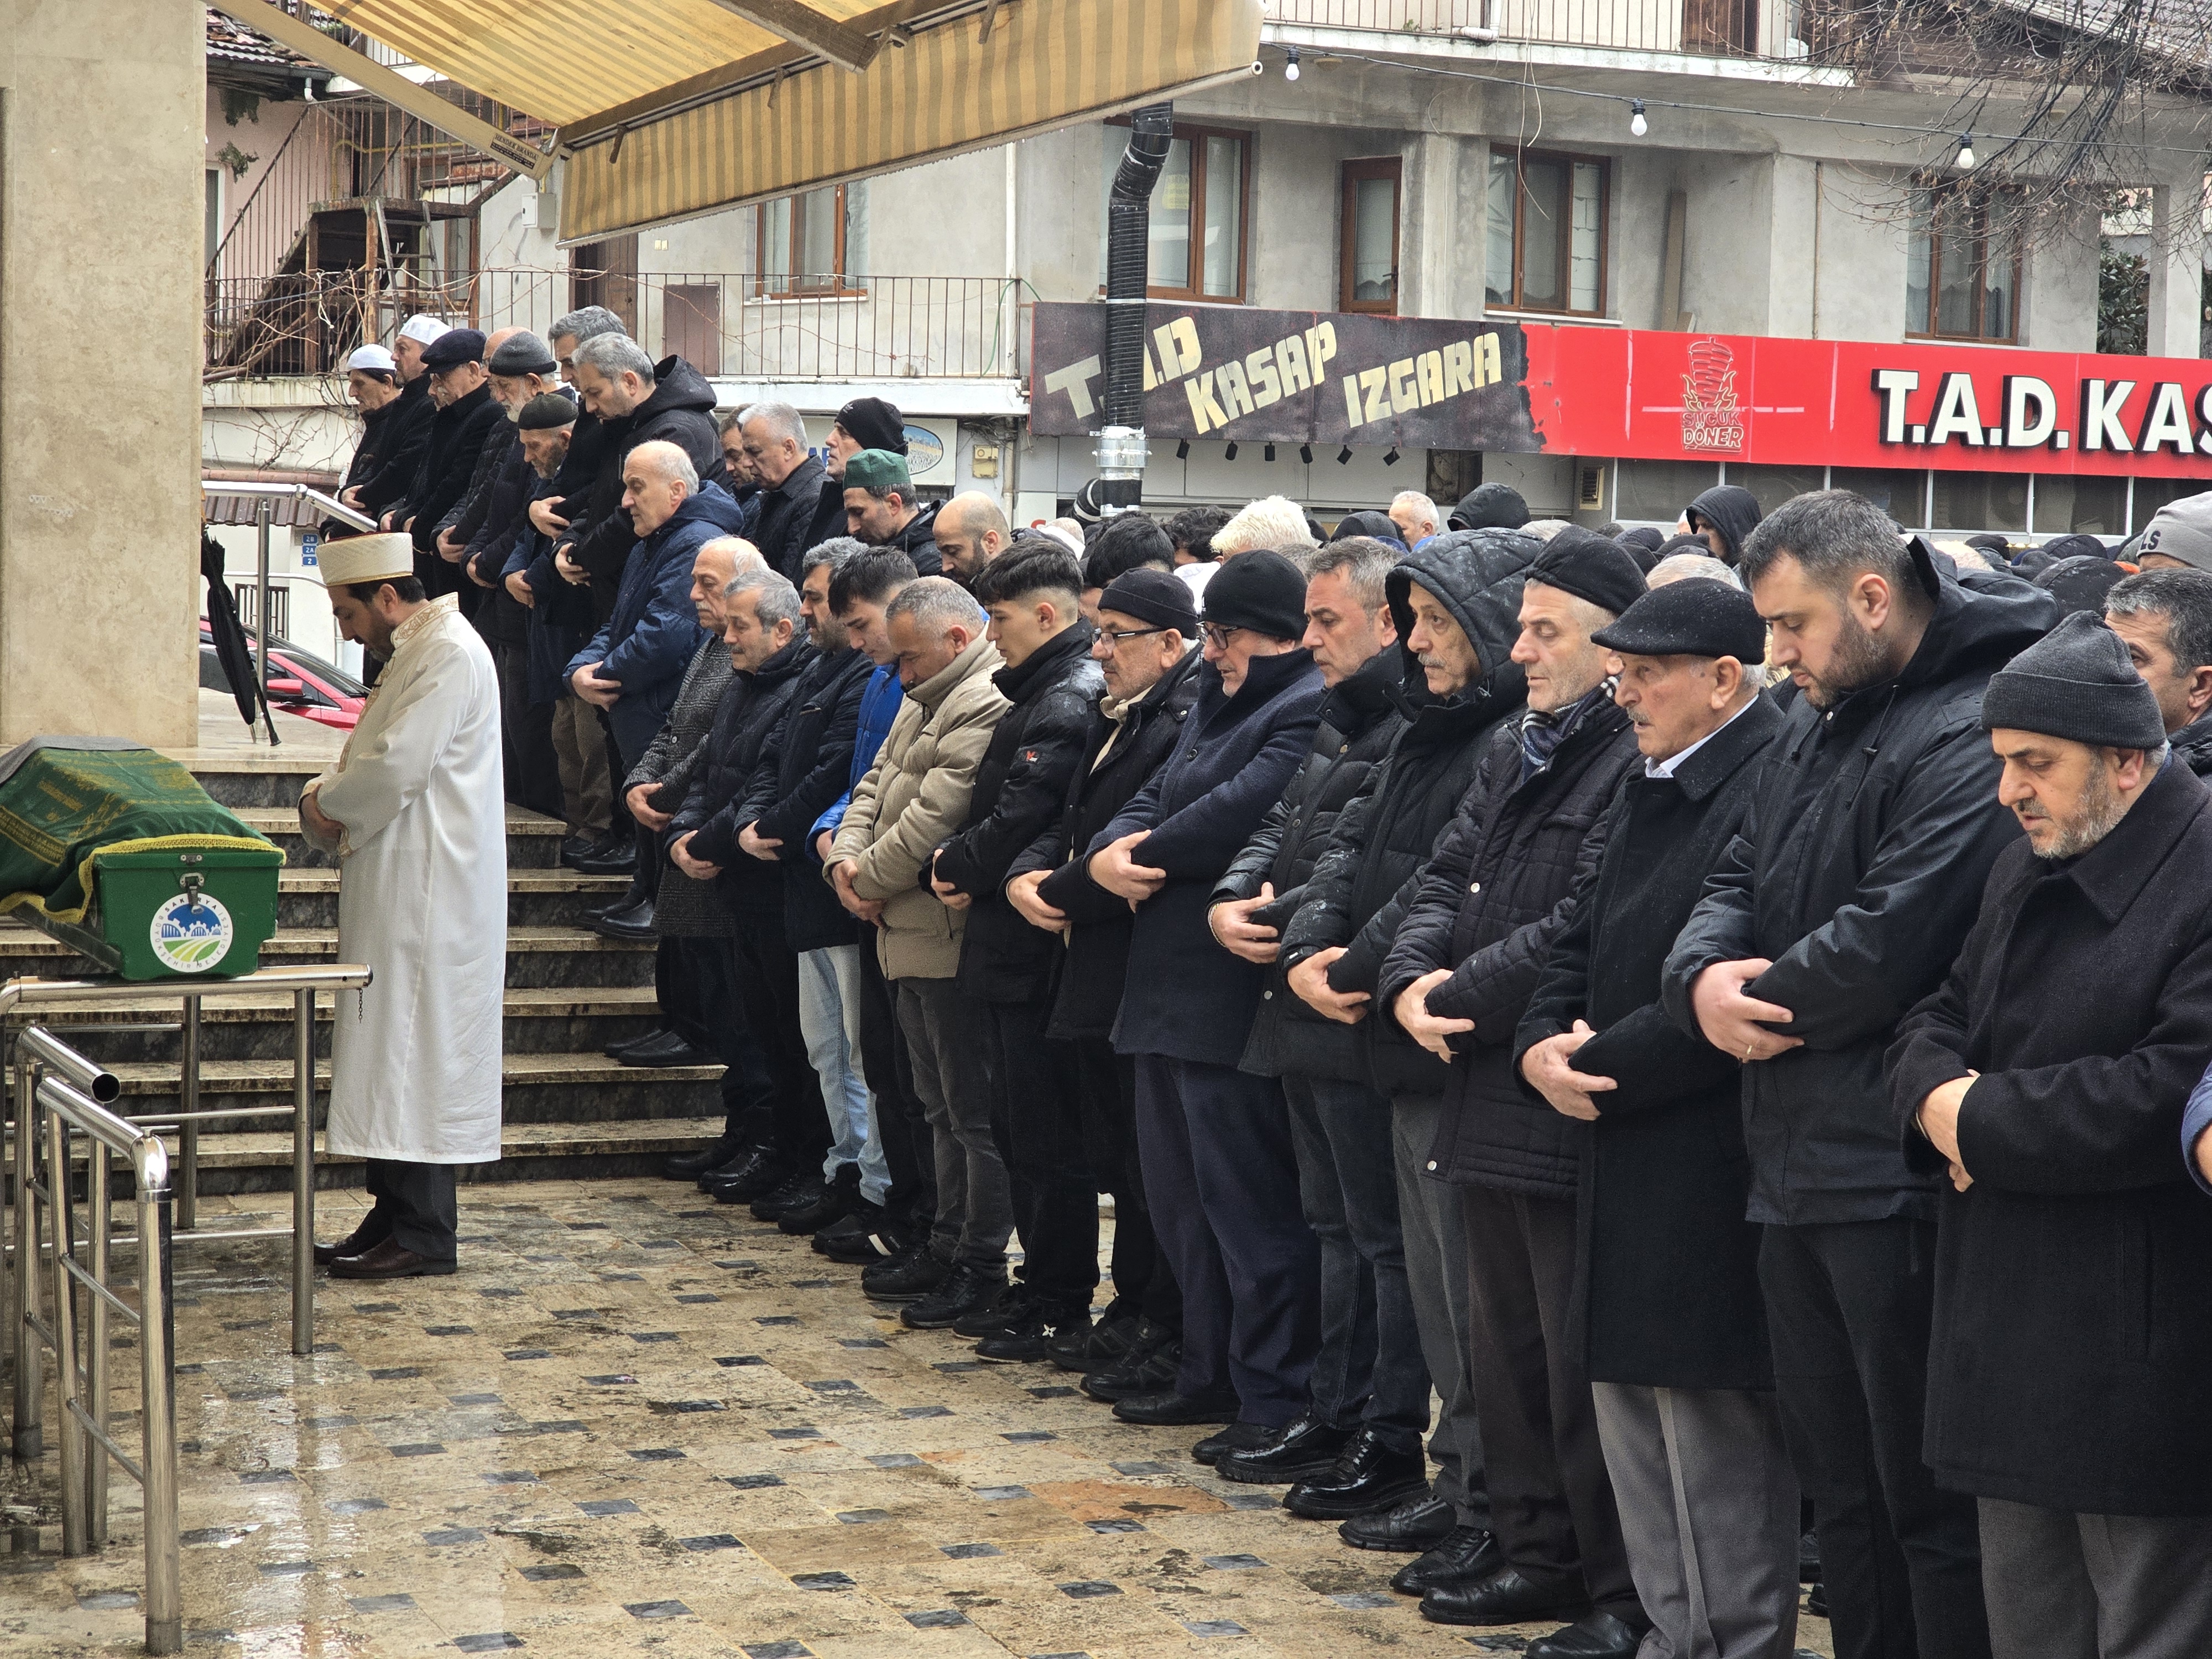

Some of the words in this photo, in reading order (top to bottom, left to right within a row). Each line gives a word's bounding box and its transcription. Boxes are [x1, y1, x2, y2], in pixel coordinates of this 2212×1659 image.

[517, 144, 539, 160] BRANDA
[1184, 321, 1337, 435] KASAP
[1343, 332, 1502, 428] IZGARA
[1871, 369, 2069, 450] T.A.D.
[1683, 421, 1744, 447] DÖNER
[165, 897, 217, 912] SAKRYA
